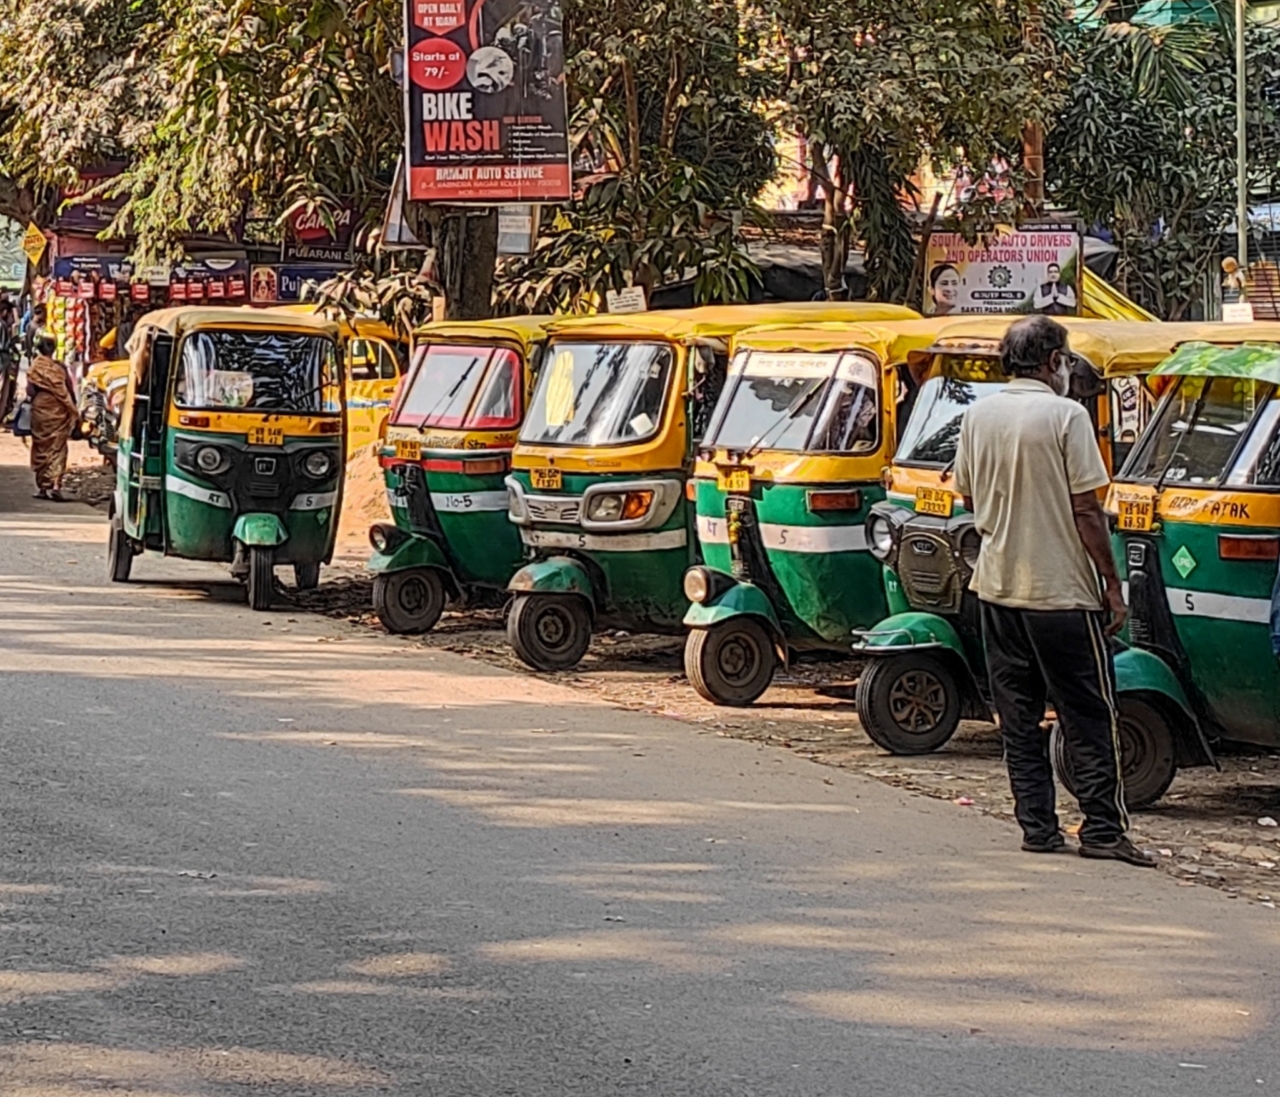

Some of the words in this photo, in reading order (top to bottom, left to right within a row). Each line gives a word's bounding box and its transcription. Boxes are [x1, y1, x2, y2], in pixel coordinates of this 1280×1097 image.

[418, 3, 438, 13] OPEN
[440, 3, 462, 13] DAILY
[423, 16, 433, 26] AT
[412, 52, 446, 61] Starts
[448, 52, 460, 61] at
[424, 66, 449, 79] 79/-
[422, 92, 472, 120] BIKE
[424, 120, 500, 152] WASH
[476, 167, 502, 180] AUTO
[504, 166, 544, 179] SERVICE
[1001, 234, 1027, 247] AUTO
[1030, 234, 1072, 248] DRIVERS
[288, 248, 342, 260] PUARANI
[946, 249, 965, 262] AND
[967, 249, 1024, 263] OPERATORS
[1026, 249, 1058, 263] UNION
[208, 493, 222, 503] RT
[305, 496, 313, 506] 5
[579, 534, 587, 547] 5
[779, 529, 789, 545] 5
[1185, 593, 1195, 611] 5
